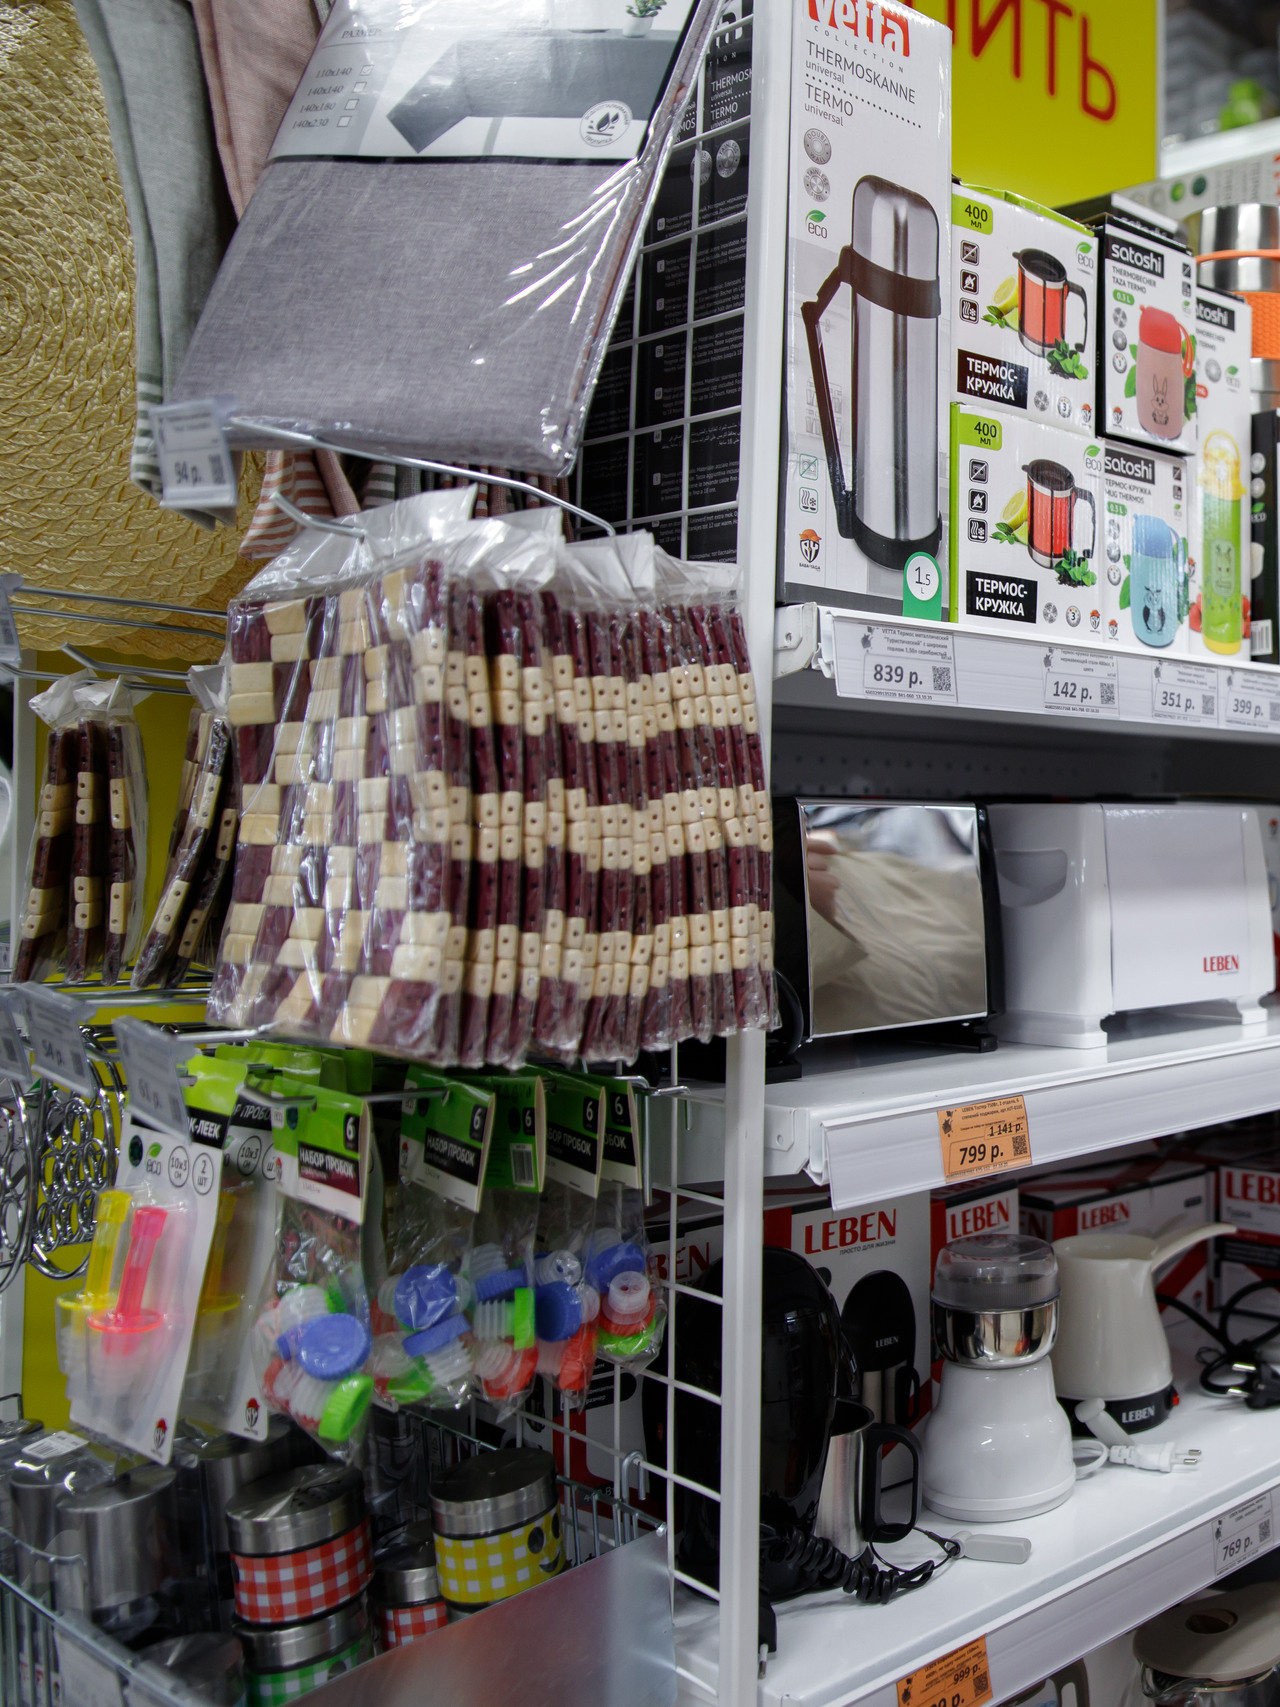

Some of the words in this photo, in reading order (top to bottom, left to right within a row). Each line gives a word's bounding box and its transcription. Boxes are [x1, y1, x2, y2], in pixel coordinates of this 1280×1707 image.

[805, 59, 846, 84] universal
[806, 40, 916, 104] THERMOSKANNE
[711, 87, 733, 101] universal
[805, 83, 854, 117] TERMO
[711, 102, 738, 120] TERMO
[804, 103, 844, 126] universal
[964, 204, 989, 223] 400
[808, 222, 828, 239] eco
[1111, 243, 1163, 278] satoshi
[1112, 265, 1156, 288] THERMOBECHER
[1112, 276, 1127, 287] TAZA
[1127, 281, 1147, 294] TERMO
[966, 357, 1018, 382] ТЕРМОС-
[966, 375, 1016, 401] КРУЖКА
[974, 422, 998, 438] 400
[1104, 458, 1153, 480] satoshi
[1105, 478, 1152, 496] ТЕРМОС-КРУЖКА
[1118, 491, 1145, 504] THERMOS
[915, 566, 931, 586] 1.5
[975, 578, 1028, 596] ТЕРМОС-
[975, 597, 1025, 617] КРУЖКА
[873, 664, 904, 683] 839
[908, 671, 923, 688] р.
[1053, 681, 1077, 698] 142
[1080, 687, 1092, 703] р.
[1161, 691, 1181, 708] 351
[1184, 698, 1195, 712] р.
[1233, 698, 1252, 714] 399
[1254, 705, 1264, 718] р.
[1203, 955, 1239, 973] LEBEN
[525, 1109, 532, 1121] 6
[586, 1101, 594, 1121] 6
[615, 1096, 623, 1116] 6
[346, 1116, 355, 1140] 6
[473, 1107, 482, 1130] 6
[997, 1122, 1013, 1135] 141
[426, 1135, 447, 1157] НАБОР
[447, 1143, 474, 1167] ПРОБОК
[562, 1134, 592, 1156] ПРОБОК
[959, 1143, 986, 1165] 799
[991, 1145, 1004, 1162] р.
[300, 1147, 325, 1167] НАБОР
[325, 1154, 354, 1179] ПРОБОК
[950, 1197, 1010, 1239] LEBEN
[1081, 1201, 1130, 1231] LEBEN
[805, 1208, 896, 1255] LEBEN
[875, 1336, 899, 1348] LEBEN
[1122, 1405, 1155, 1424] LEBEN
[1222, 1538, 1241, 1561] 769
[1243, 1536, 1253, 1553] р.
[953, 1666, 970, 1685] 999
[972, 1663, 981, 1676] р.
